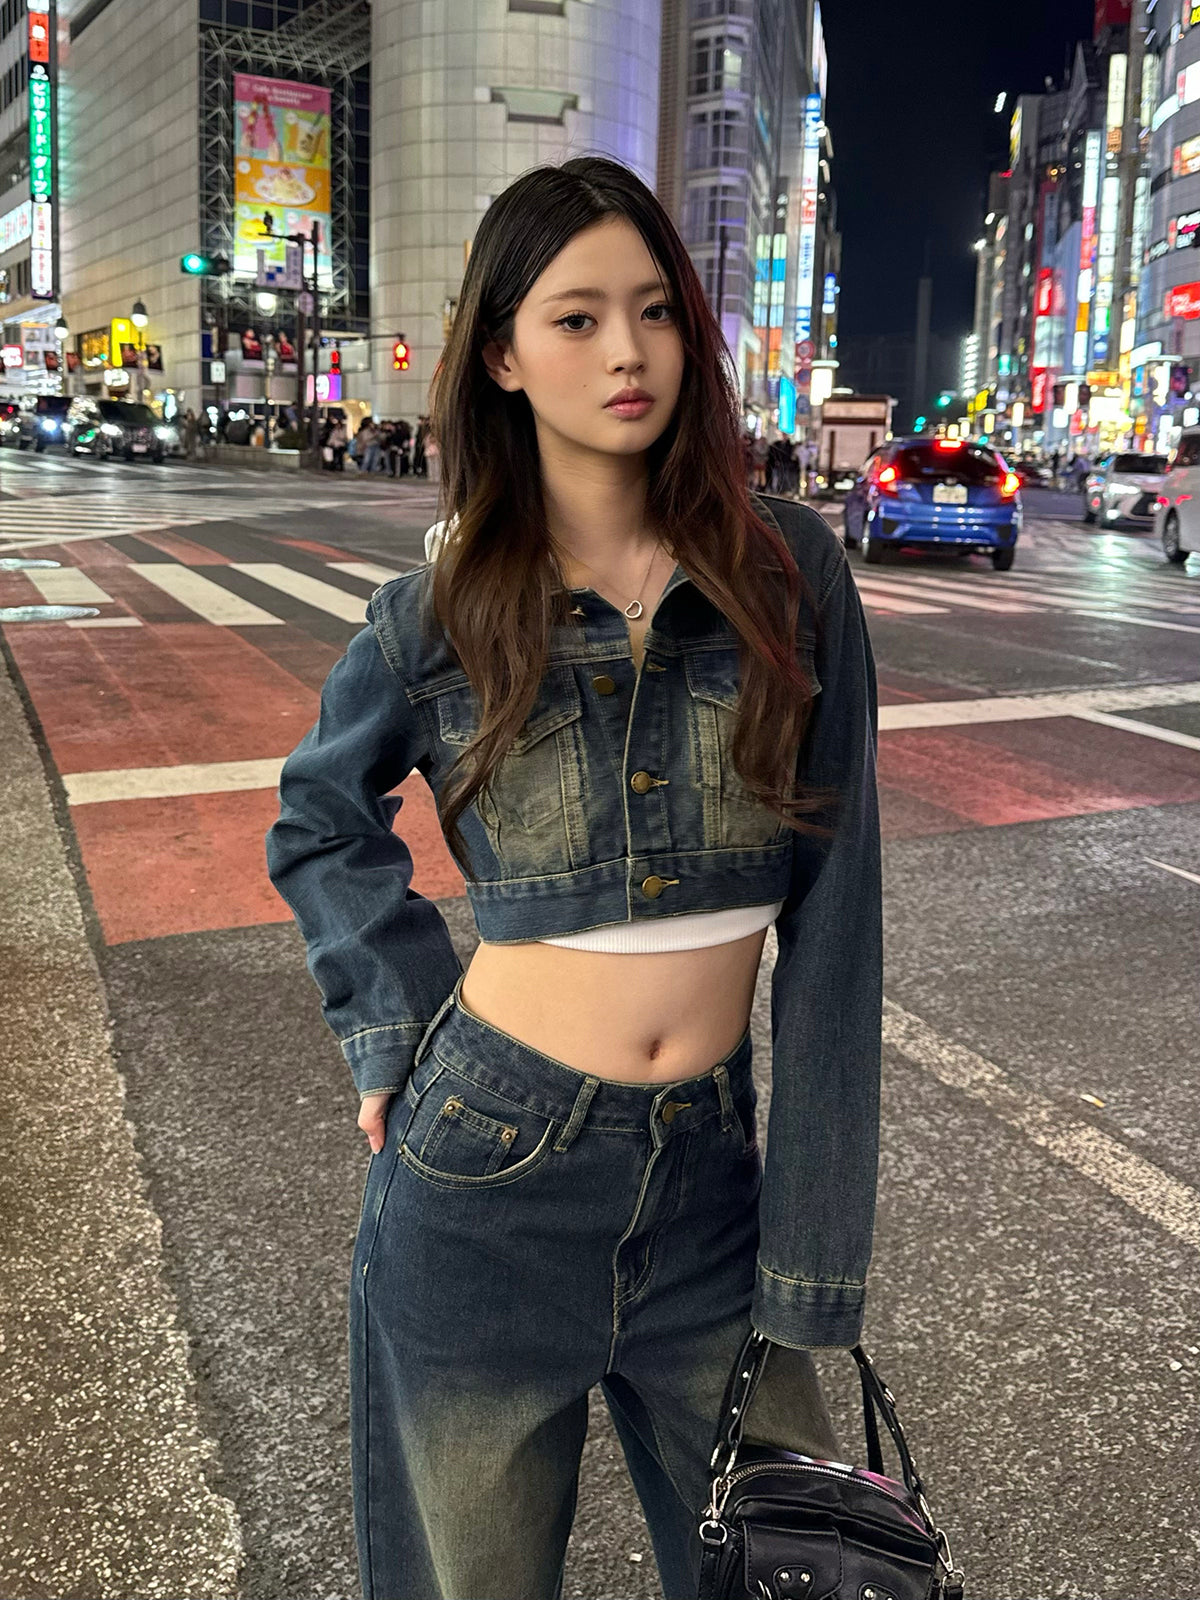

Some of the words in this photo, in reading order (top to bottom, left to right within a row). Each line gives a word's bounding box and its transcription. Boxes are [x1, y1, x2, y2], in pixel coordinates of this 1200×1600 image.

[32, 82, 48, 193] ビリヤード・ダーツ
[801, 188, 816, 225] LABI
